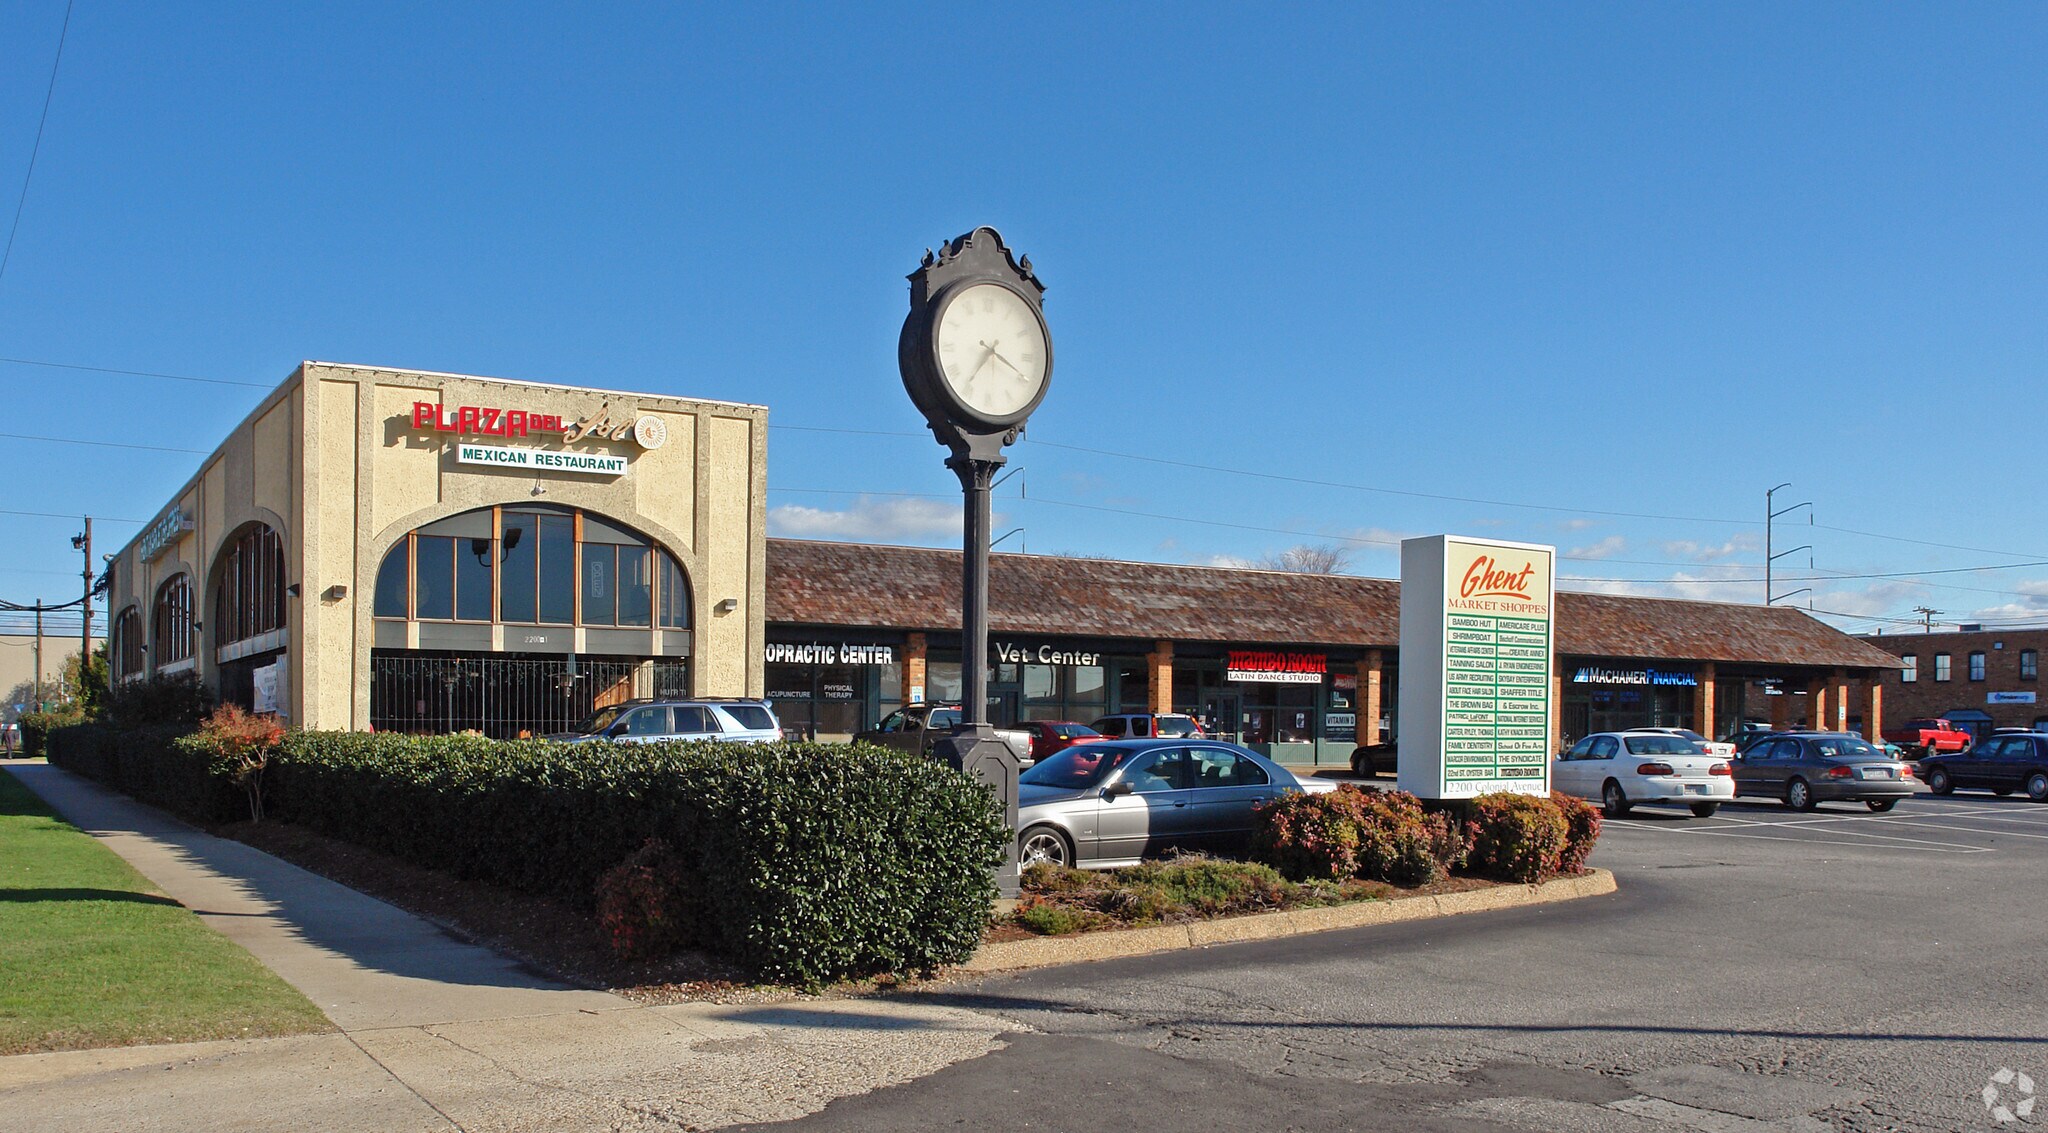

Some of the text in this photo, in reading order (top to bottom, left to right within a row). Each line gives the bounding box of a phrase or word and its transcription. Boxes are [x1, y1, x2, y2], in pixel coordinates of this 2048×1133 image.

[413, 401, 527, 438] PLAZA
[530, 414, 568, 433] DEL
[463, 448, 624, 471] MEXICAN RESTAURANT
[1460, 555, 1535, 598] Ghent
[1448, 598, 1547, 614] MARKET SHOPPES
[1453, 618, 1491, 628] BAMBOO HUT
[1499, 621, 1545, 631] AMERICARE PLUS
[1453, 632, 1491, 641] SHRIMPBOAT
[764, 643, 893, 665] OPRACTIC CENTER
[996, 642, 1100, 666] Vet Center
[1509, 649, 1529, 657] CREATIVE
[1449, 660, 1475, 668] TANNING
[1257, 673, 1286, 681] DANCE
[1286, 674, 1320, 682] STUDIO
[1456, 673, 1468, 681] ARMY
[1469, 674, 1494, 682] RECRUITING
[824, 684, 854, 692] PHYSICAL
[660, 689, 687, 697] NUTRTI
[824, 691, 853, 699] THERAPY
[1461, 701, 1481, 709] BROWN
[1499, 755, 1543, 763] THE SYNDICATE
[1449, 782, 1473, 793] 2200
[1512, 781, 1542, 792] Avenue
